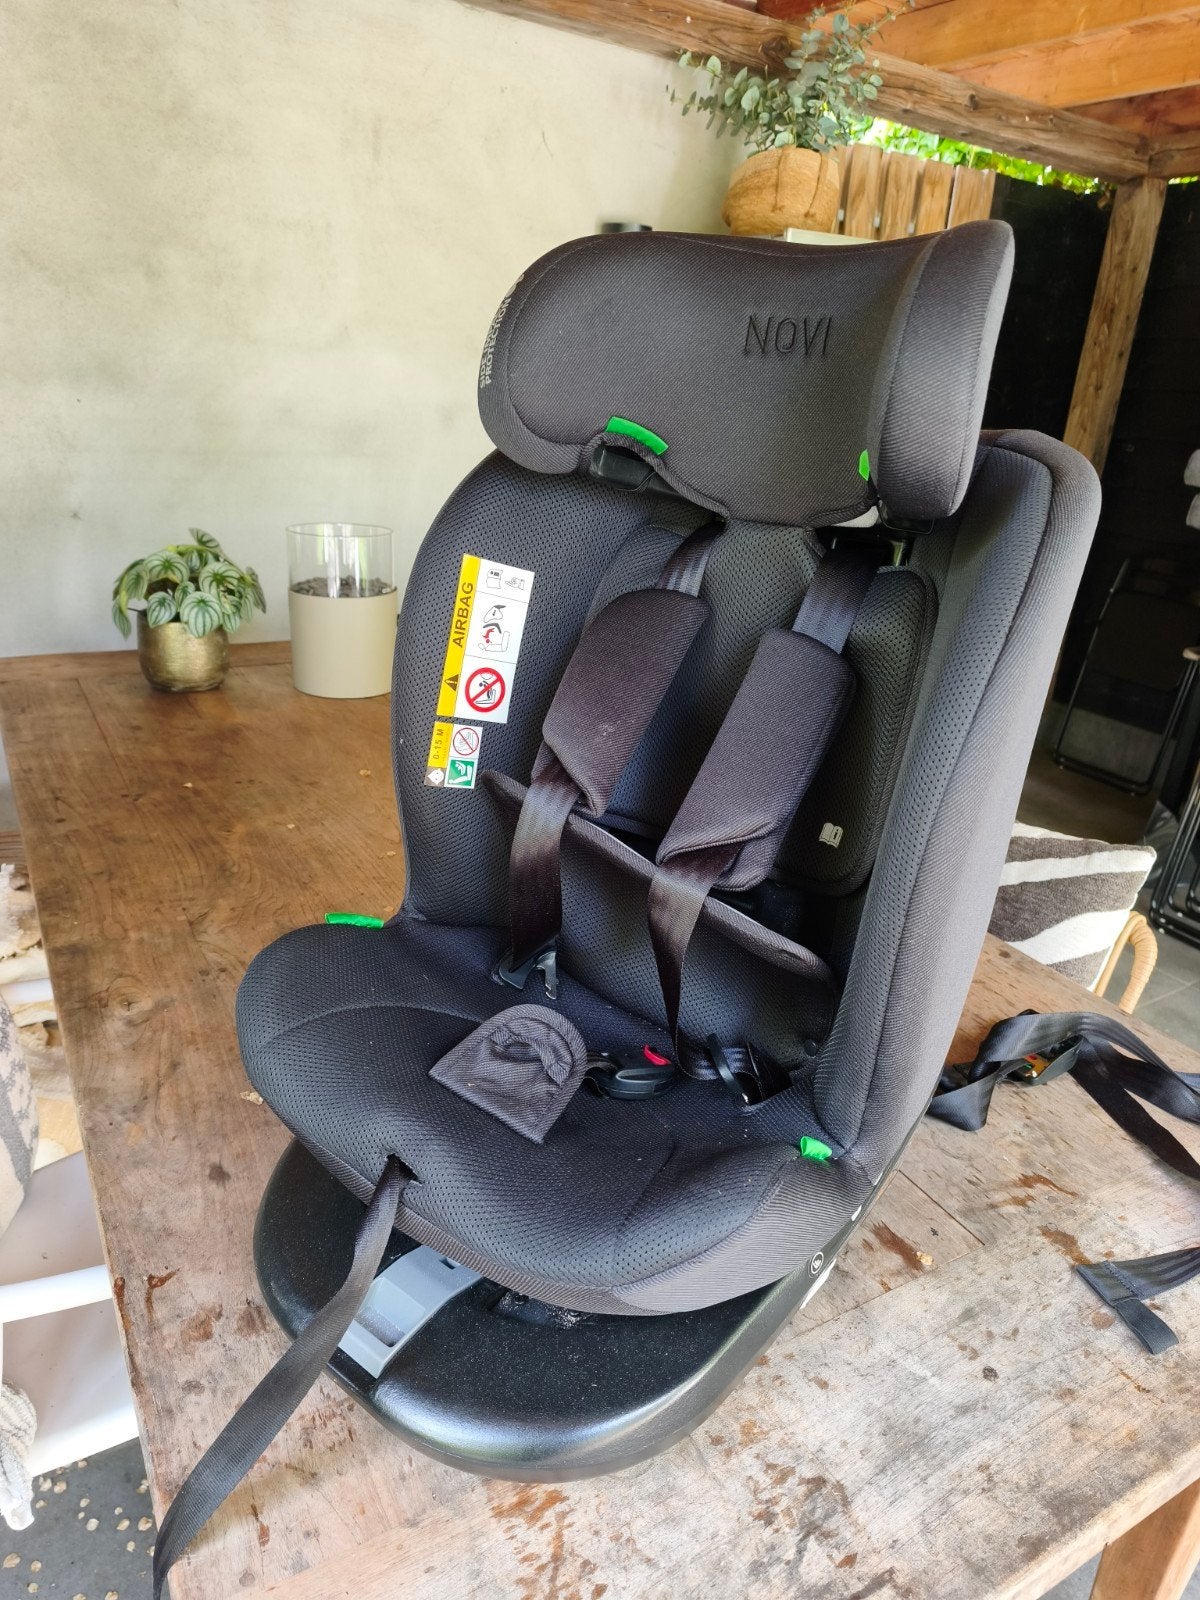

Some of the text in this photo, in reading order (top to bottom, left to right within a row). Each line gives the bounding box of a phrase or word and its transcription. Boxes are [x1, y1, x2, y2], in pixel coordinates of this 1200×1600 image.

[485, 298, 512, 385] PROTECTION
[744, 315, 832, 356] NOVI
[452, 581, 474, 648] AIRBAG
